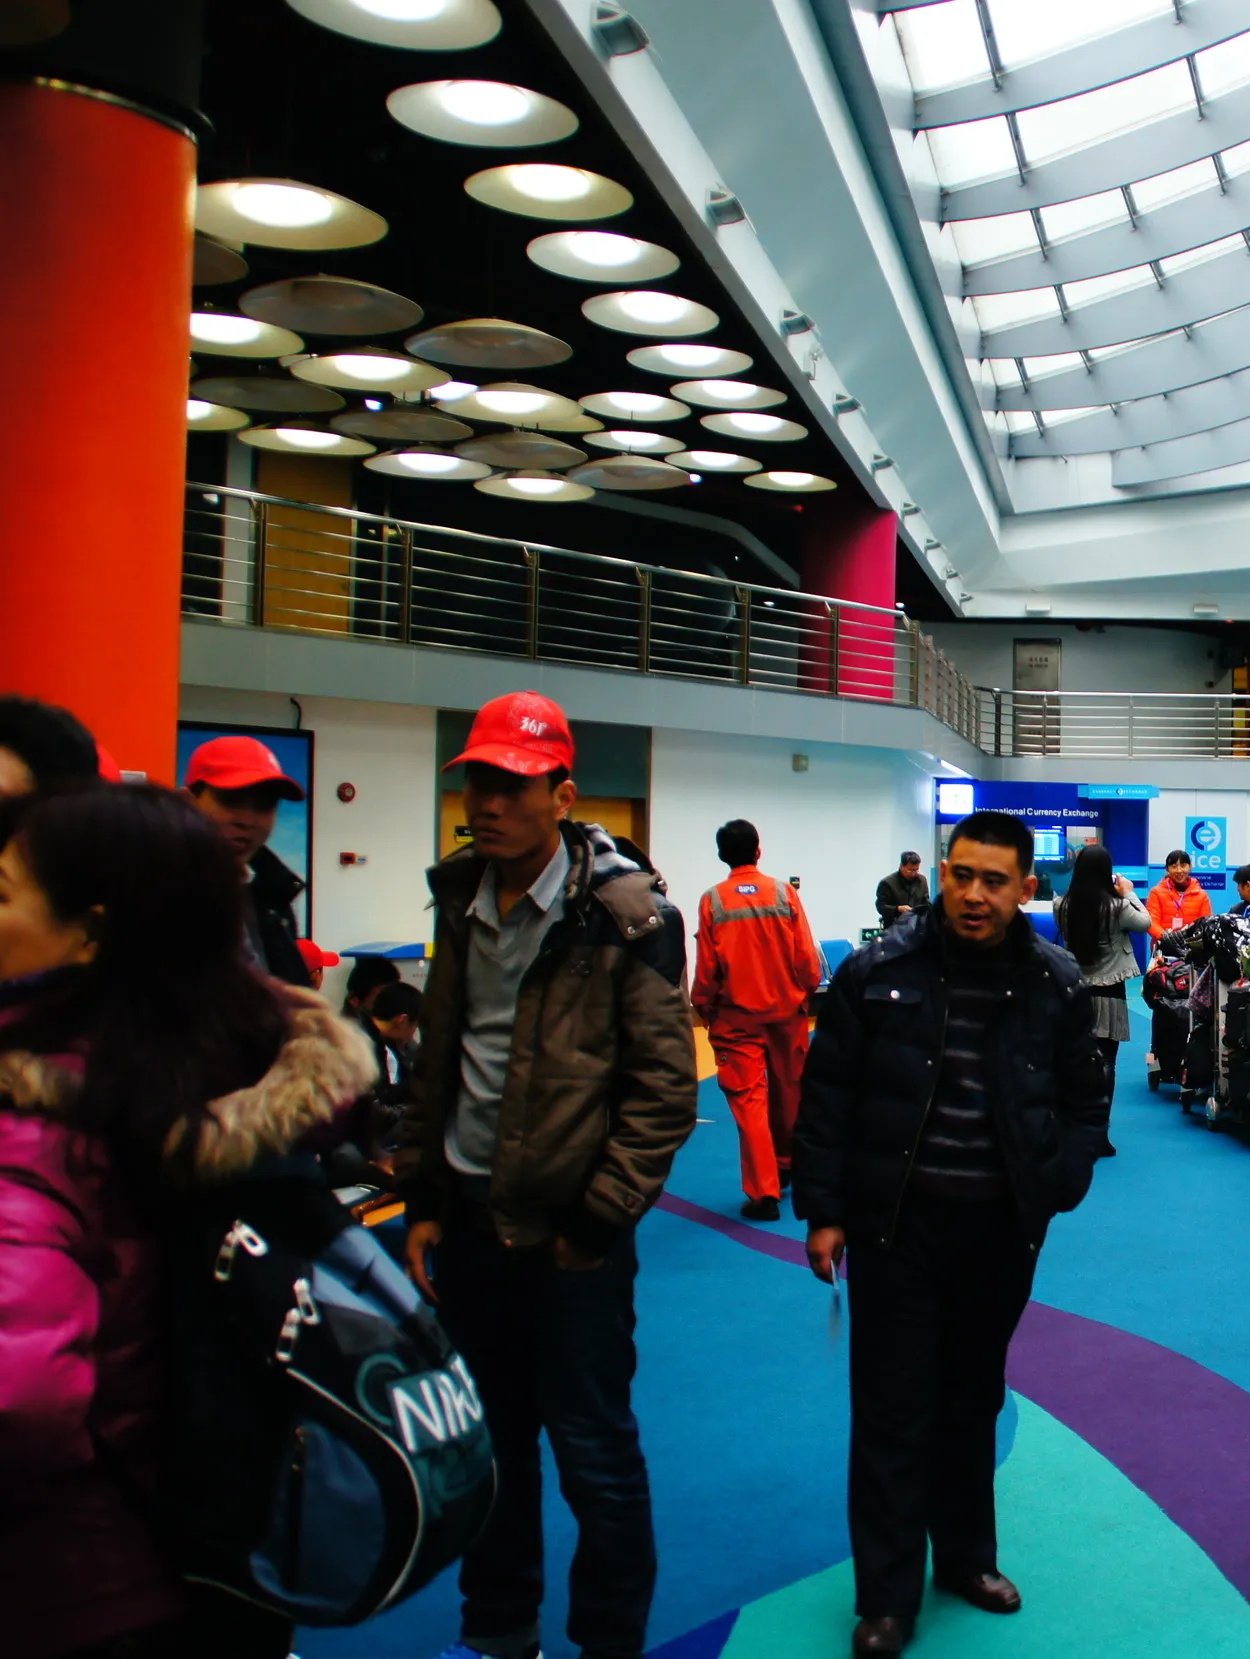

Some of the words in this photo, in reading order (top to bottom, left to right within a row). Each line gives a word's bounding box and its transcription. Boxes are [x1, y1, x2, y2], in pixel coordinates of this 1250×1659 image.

[1027, 808, 1061, 818] Currency
[1063, 809, 1099, 819] Exchange
[1191, 851, 1221, 868] ice
